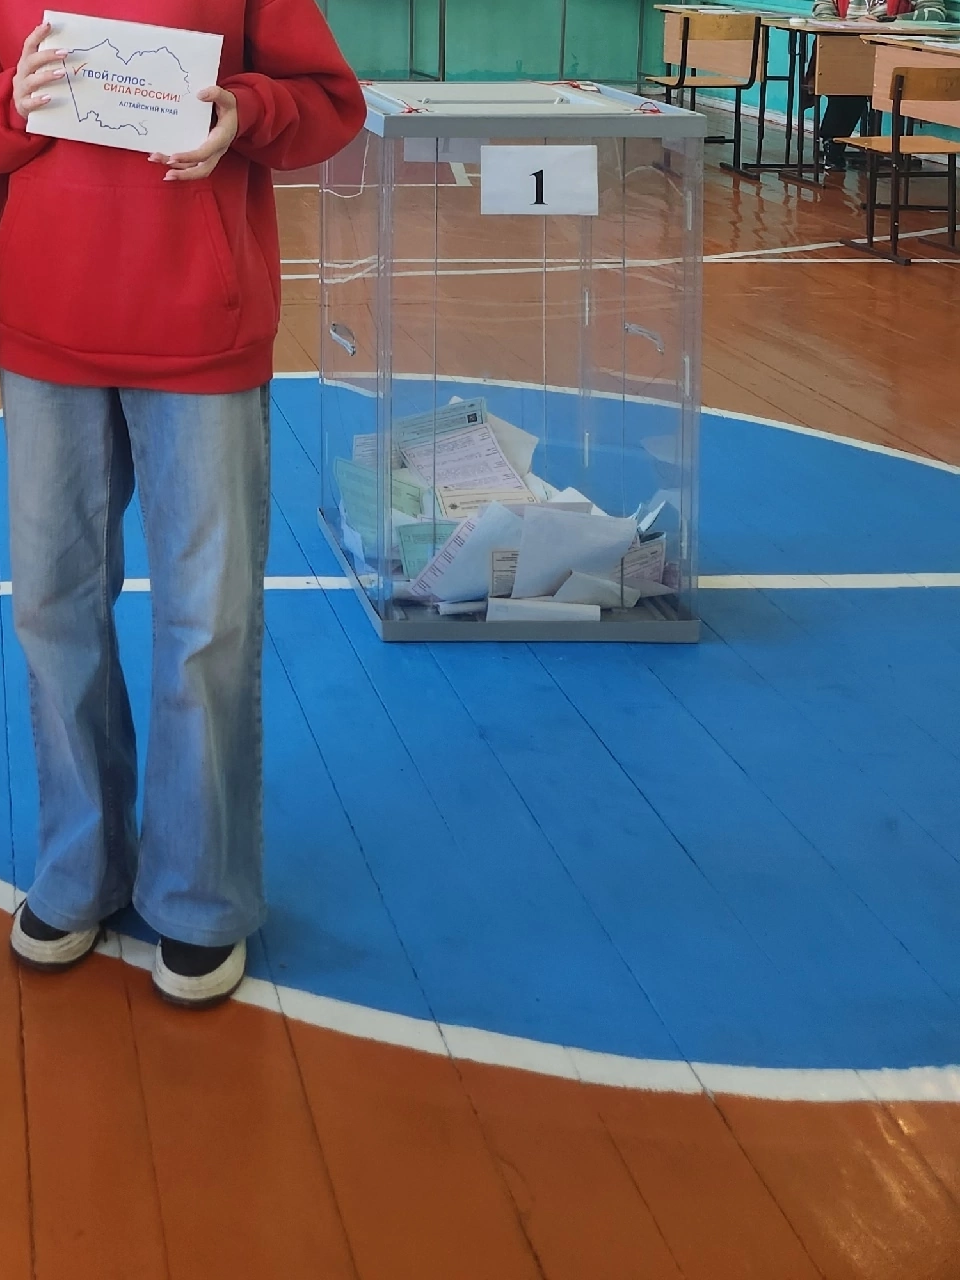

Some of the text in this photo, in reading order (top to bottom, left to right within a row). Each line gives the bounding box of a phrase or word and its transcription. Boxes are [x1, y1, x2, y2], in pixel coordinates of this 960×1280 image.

[82, 68, 109, 81] ТВОЙ
[111, 73, 146, 86] ГОЛОС
[103, 82, 181, 102] СИЛА РОССИИ!
[118, 100, 179, 116] АЛТАЙСКИЙ КРАЙ
[528, 168, 549, 206] 1
